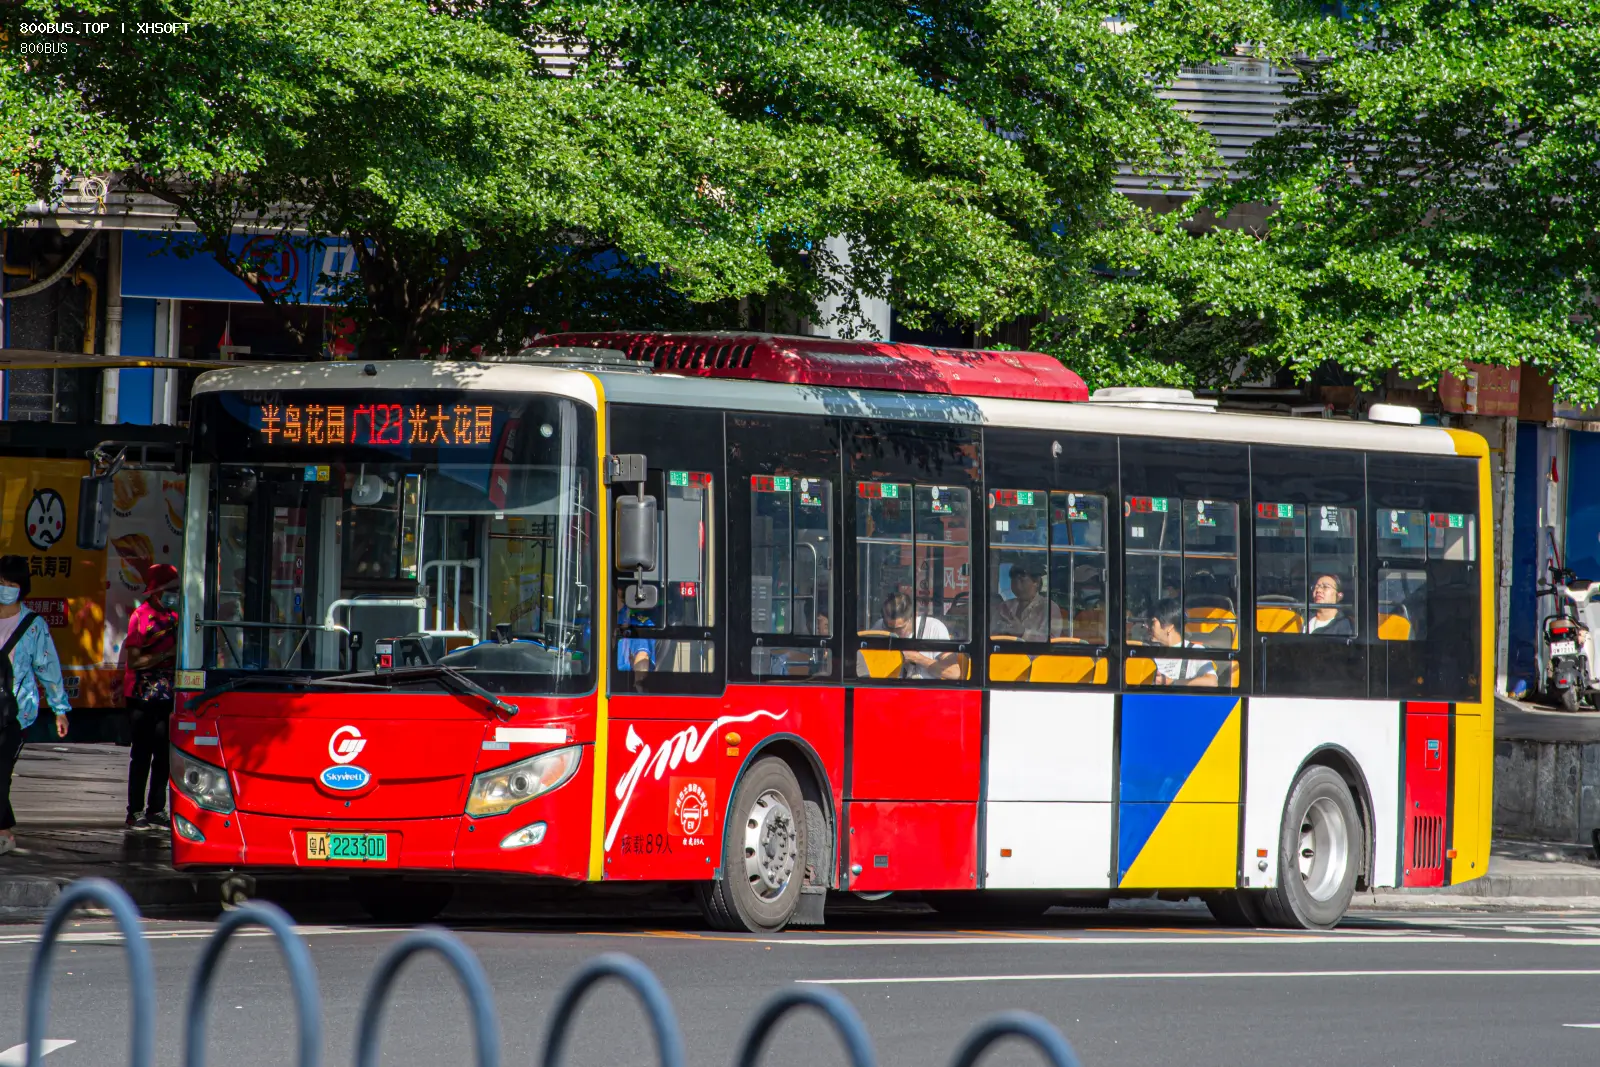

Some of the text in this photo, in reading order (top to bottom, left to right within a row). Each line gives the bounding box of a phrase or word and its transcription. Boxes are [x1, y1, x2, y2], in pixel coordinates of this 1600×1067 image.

[260, 404, 493, 444] 半岛花园 广123 光大花园
